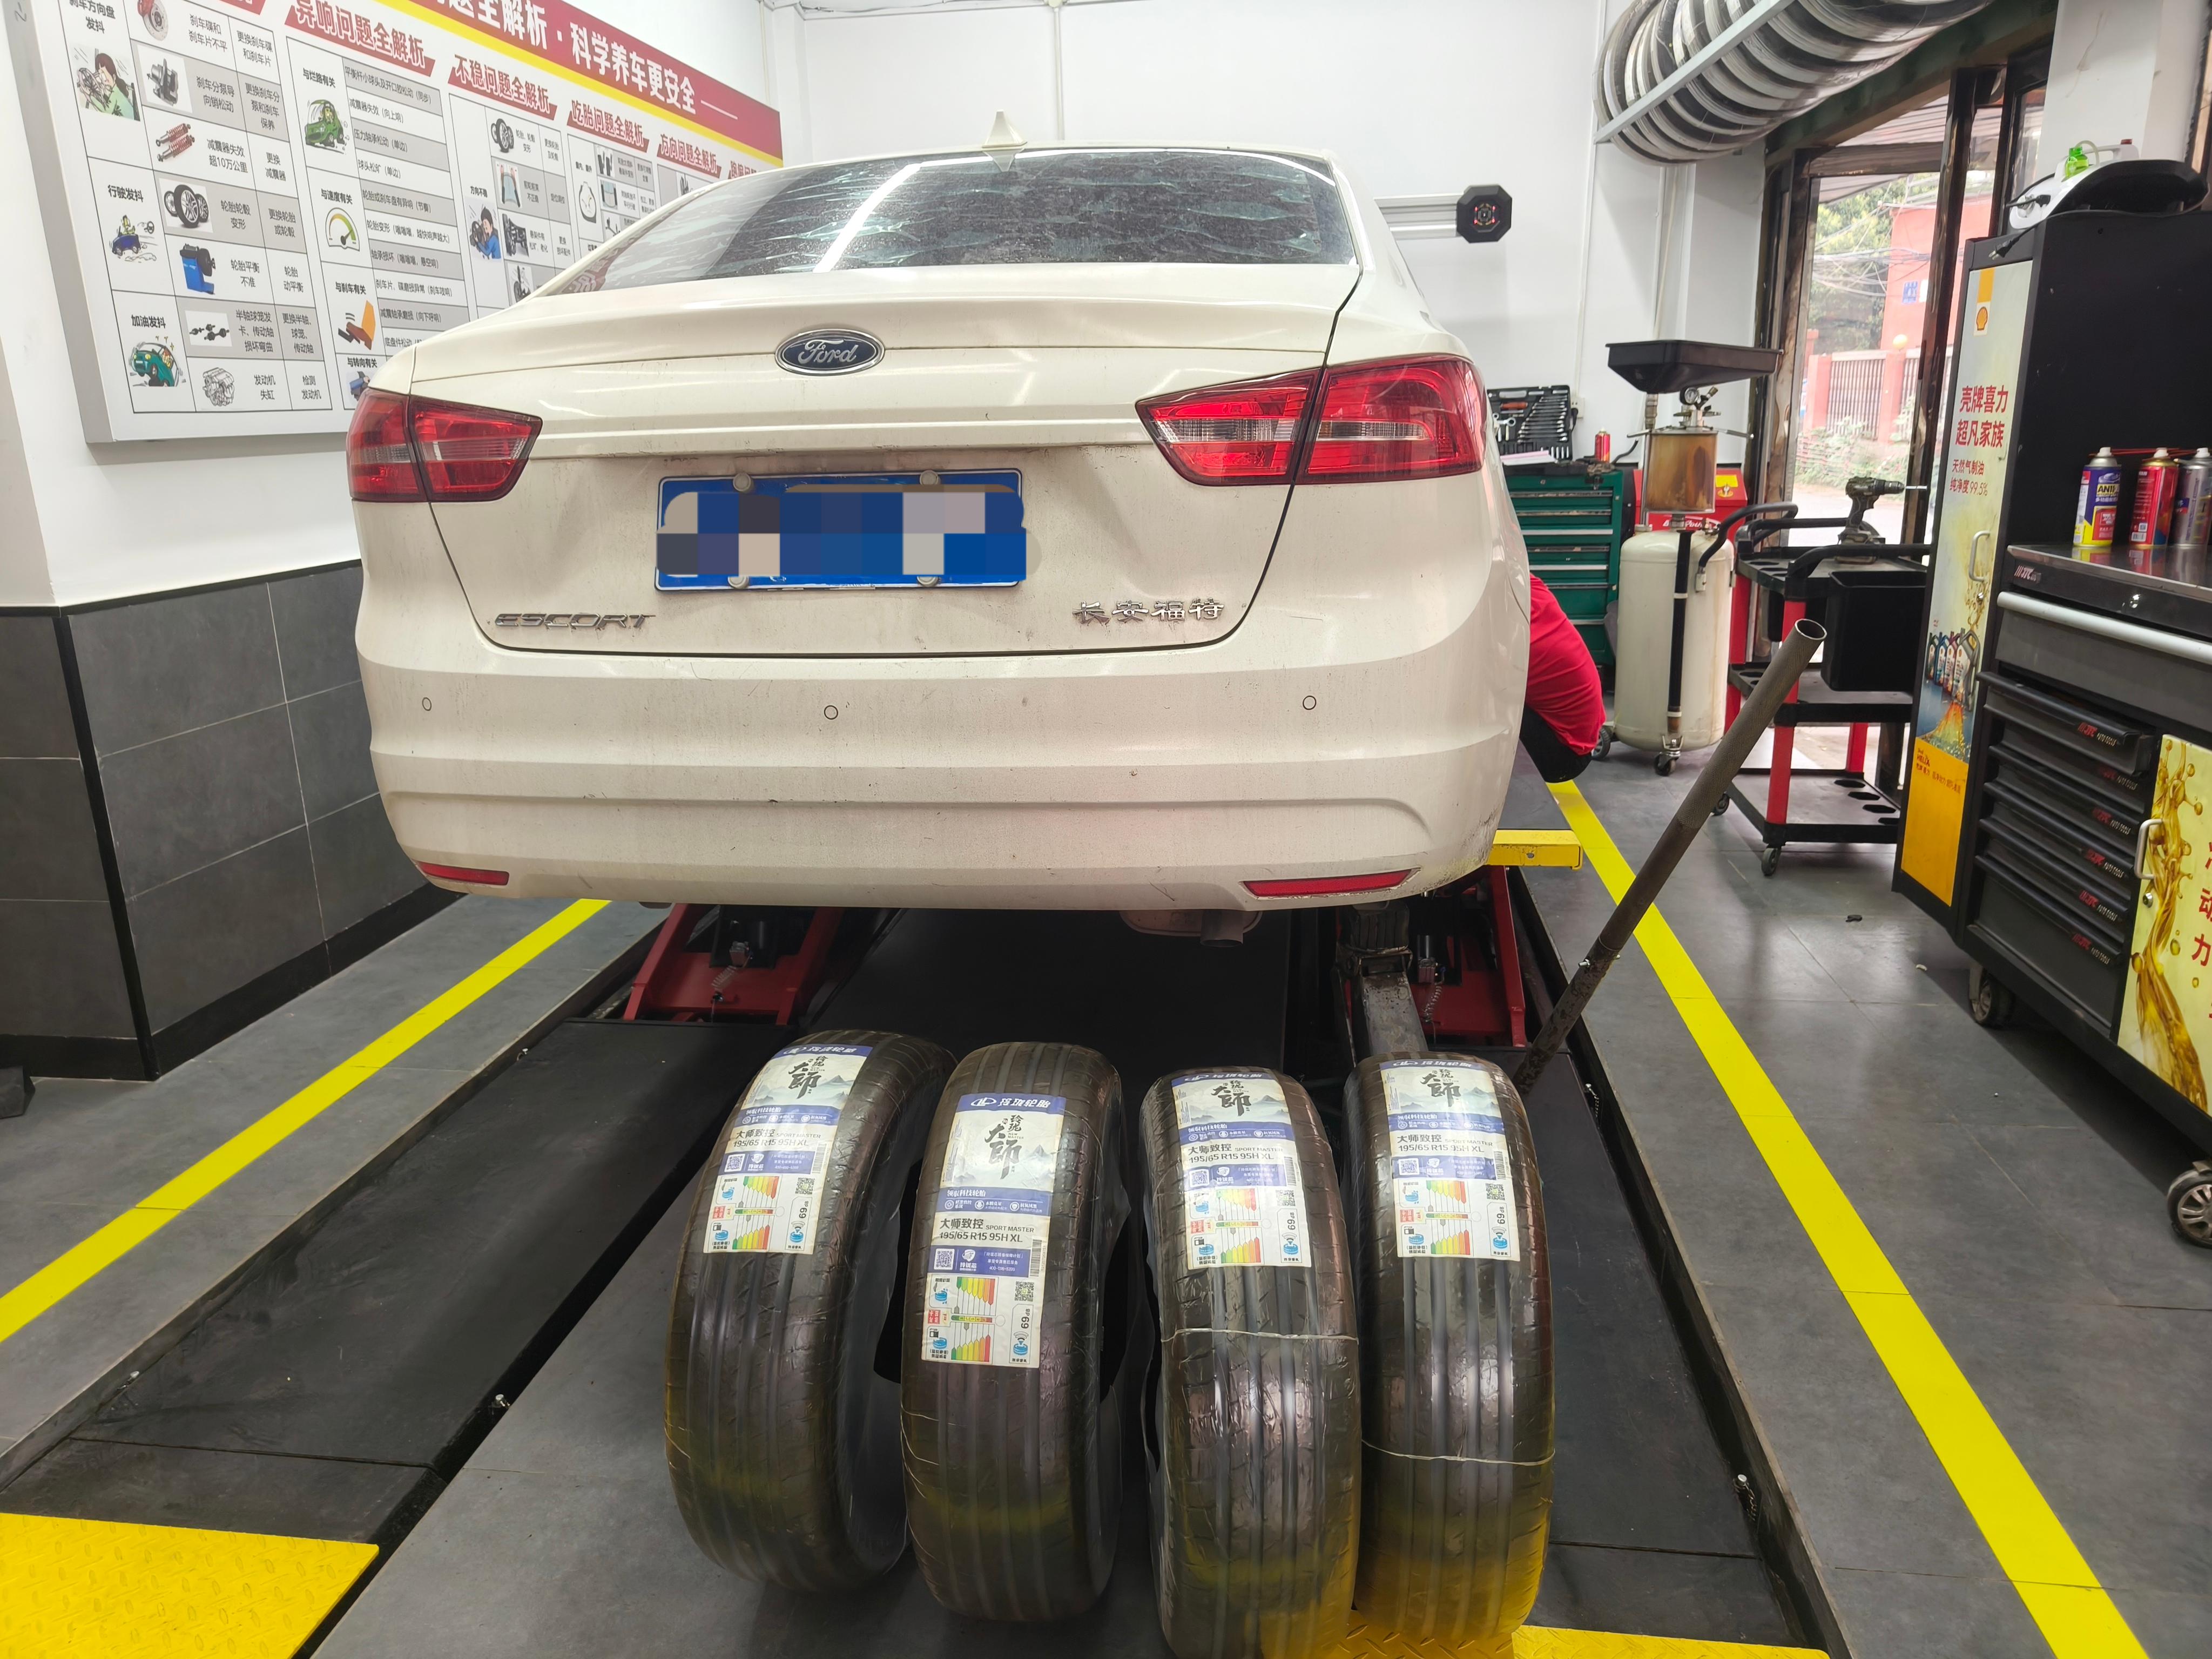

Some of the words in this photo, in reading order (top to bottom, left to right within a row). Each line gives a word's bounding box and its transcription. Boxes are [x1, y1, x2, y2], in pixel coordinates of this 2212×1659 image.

[85, 16, 105, 33] 发抖
[190, 14, 221, 35] 刹车碟和
[188, 30, 227, 52] 刹车片不平
[295, 0, 426, 69] 异响问题全解析
[243, 48, 271, 67] 和刹车片
[570, 22, 696, 114] 科学养车更安全
[303, 68, 336, 88] 与烂路有关
[455, 54, 550, 114] 不稳问题全解析
[196, 76, 235, 97] 刹车分泵导
[245, 83, 280, 103] 更换刹车分
[203, 95, 234, 112] 向销松动
[251, 99, 279, 117] 泵和刹车
[261, 117, 275, 131] 保养
[571, 100, 644, 147] 吃胎问题全解析
[266, 152, 281, 165] 更换
[660, 134, 718, 174] 方向问题全解析
[209, 155, 248, 173] 超10万公里
[107, 185, 143, 203] 行驶发抖
[321, 188, 353, 204] 与速度有关
[221, 200, 251, 215] 轮胎轮毂
[268, 208, 296, 224] 更换轮胎
[231, 217, 246, 230] 变形
[274, 225, 295, 238] 或轮毂
[231, 259, 260, 274] 轮胎平衡
[284, 266, 298, 277] 轮胎
[240, 276, 255, 288] 不准
[284, 280, 304, 293] 动平衡
[335, 281, 366, 295] 与刹车有关
[131, 314, 166, 328] 加油发抖
[236, 309, 272, 322] 半轴球笼发
[238, 326, 274, 338] 卡、传动轴
[245, 341, 273, 352] 损坏弯曲
[294, 342, 314, 354] 传动轴
[798, 339, 859, 364] Ford
[347, 357, 377, 368] 与转向有关
[254, 374, 276, 386] 发动机
[302, 375, 316, 386] 检测
[260, 389, 275, 400] 失缸
[301, 389, 321, 400] 发动机
[1959, 385, 2008, 413] 壳牌喜力
[1955, 419, 2005, 448] 超凡家族
[1952, 459, 1984, 475] 天然气制油
[1073, 597, 1224, 623] 长安福特
[495, 613, 656, 628] ESCORT
[998, 1097, 1051, 1108] 玲珑轮胎
[1007, 1115, 1024, 1132] 玲珑
[736, 1129, 775, 1139] 大师致控
[1397, 1134, 1442, 1143] 大师致控
[733, 1139, 759, 1148] 195/65
[1188, 1143, 1232, 1155] 大师致控
[1189, 1154, 1219, 1163] 195/65
[799, 1207, 807, 1218] 69
[1496, 1213, 1506, 1224] 69
[940, 1218, 983, 1230] 大师致控
[1287, 1219, 1296, 1230] 69
[939, 1231, 968, 1240] 195/65
[970, 1232, 987, 1240] R15
[989, 1232, 1008, 1242] 95H
[1010, 1234, 1023, 1242] XL
[1021, 1316, 1029, 1329] 69
